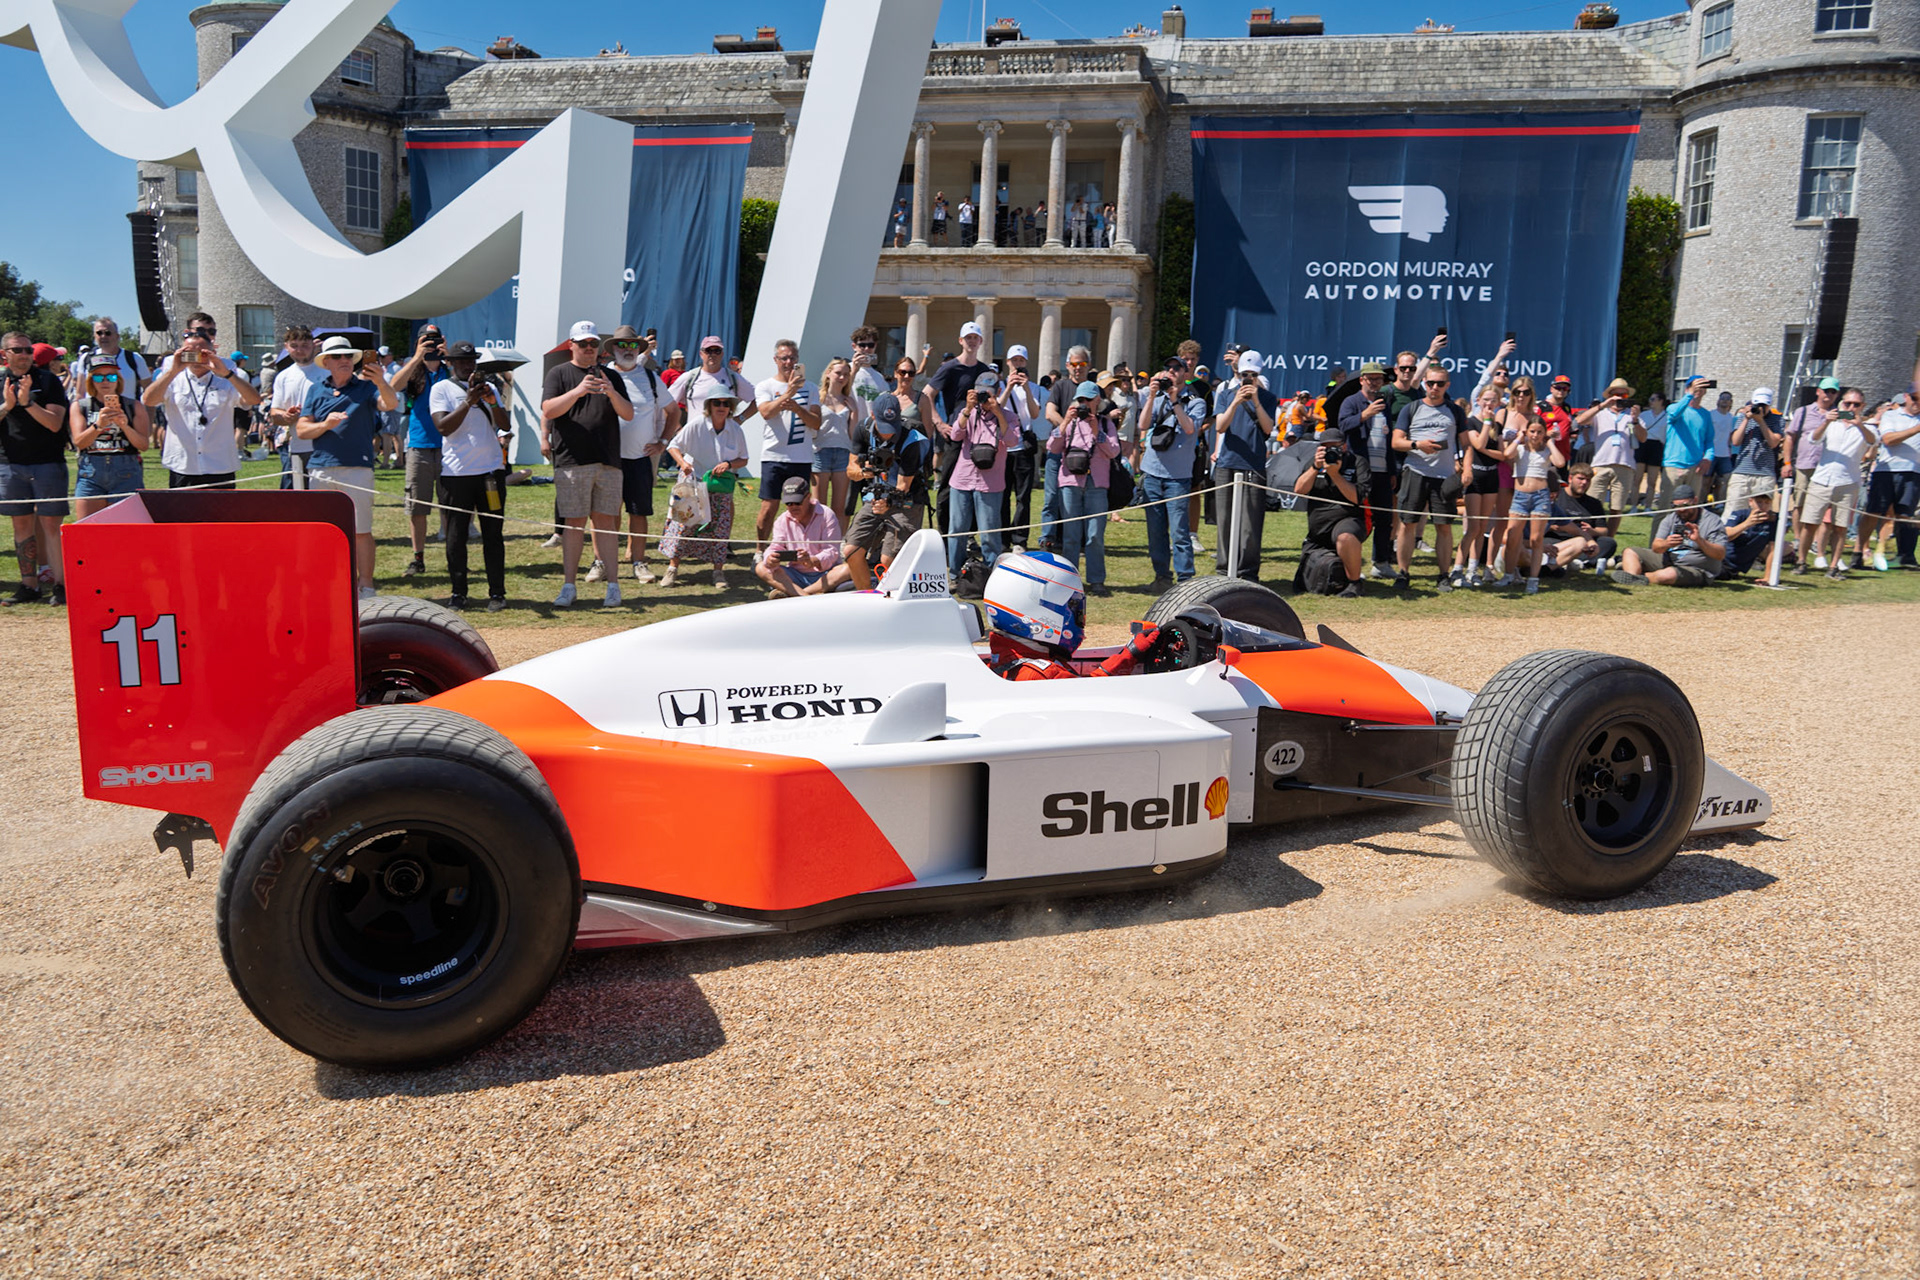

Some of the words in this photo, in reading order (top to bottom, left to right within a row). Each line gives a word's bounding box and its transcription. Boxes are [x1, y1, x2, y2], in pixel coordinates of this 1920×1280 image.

[1305, 261, 1398, 277] GORDON
[1404, 261, 1494, 278] MURRAY
[1304, 284, 1493, 302] AUTOMOTIVE
[1262, 354, 1288, 370] MA
[1293, 355, 1328, 370] V12
[1441, 357, 1470, 373] OF
[1474, 358, 1552, 376] SUND
[908, 581, 946, 594] BOSS
[924, 572, 946, 581] Prost
[101, 614, 181, 687] 11
[726, 683, 818, 699] POWERED
[823, 683, 844, 695] by
[727, 697, 883, 724] HOND
[1271, 747, 1296, 766] 422
[99, 761, 214, 788] SHOWA
[1041, 782, 1200, 838] Shell
[252, 799, 331, 910] AVON
[399, 957, 459, 985] speedline
